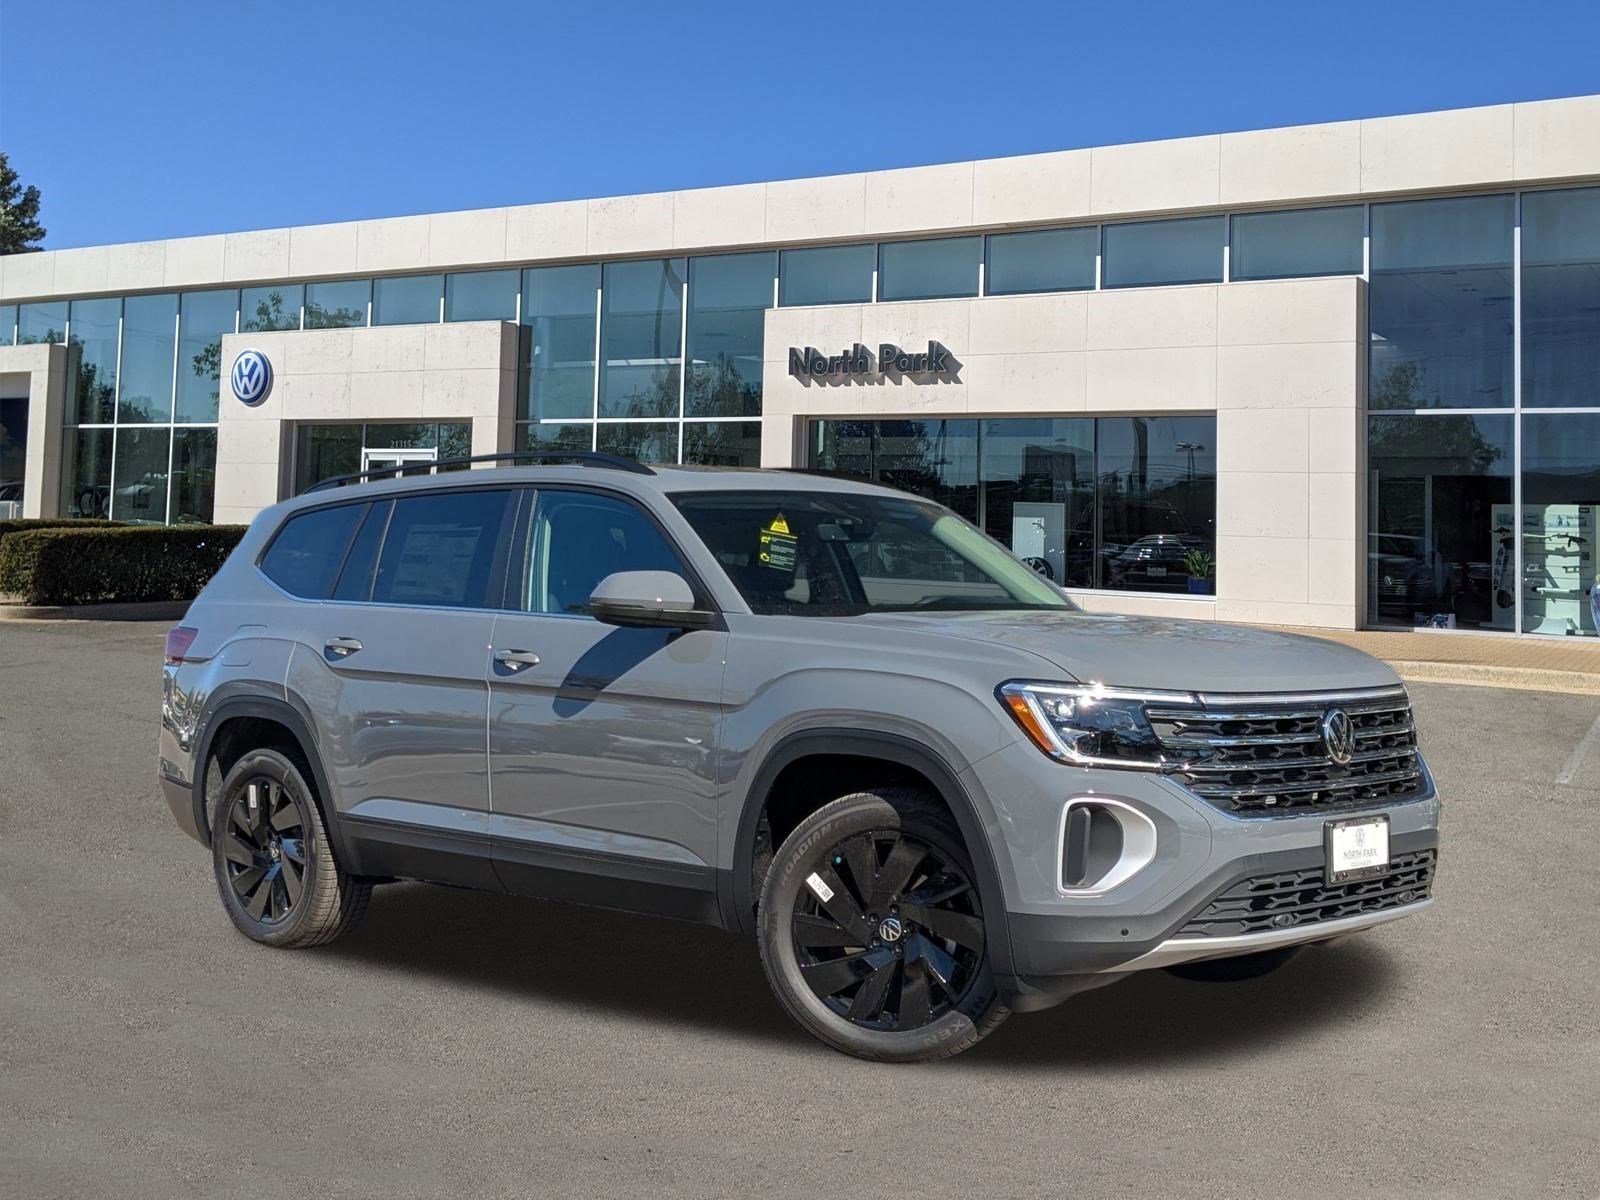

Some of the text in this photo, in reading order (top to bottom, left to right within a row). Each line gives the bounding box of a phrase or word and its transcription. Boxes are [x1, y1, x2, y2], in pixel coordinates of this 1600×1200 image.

[233, 352, 265, 399] VW
[788, 340, 947, 376] North Park
[390, 440, 412, 449] 21315
